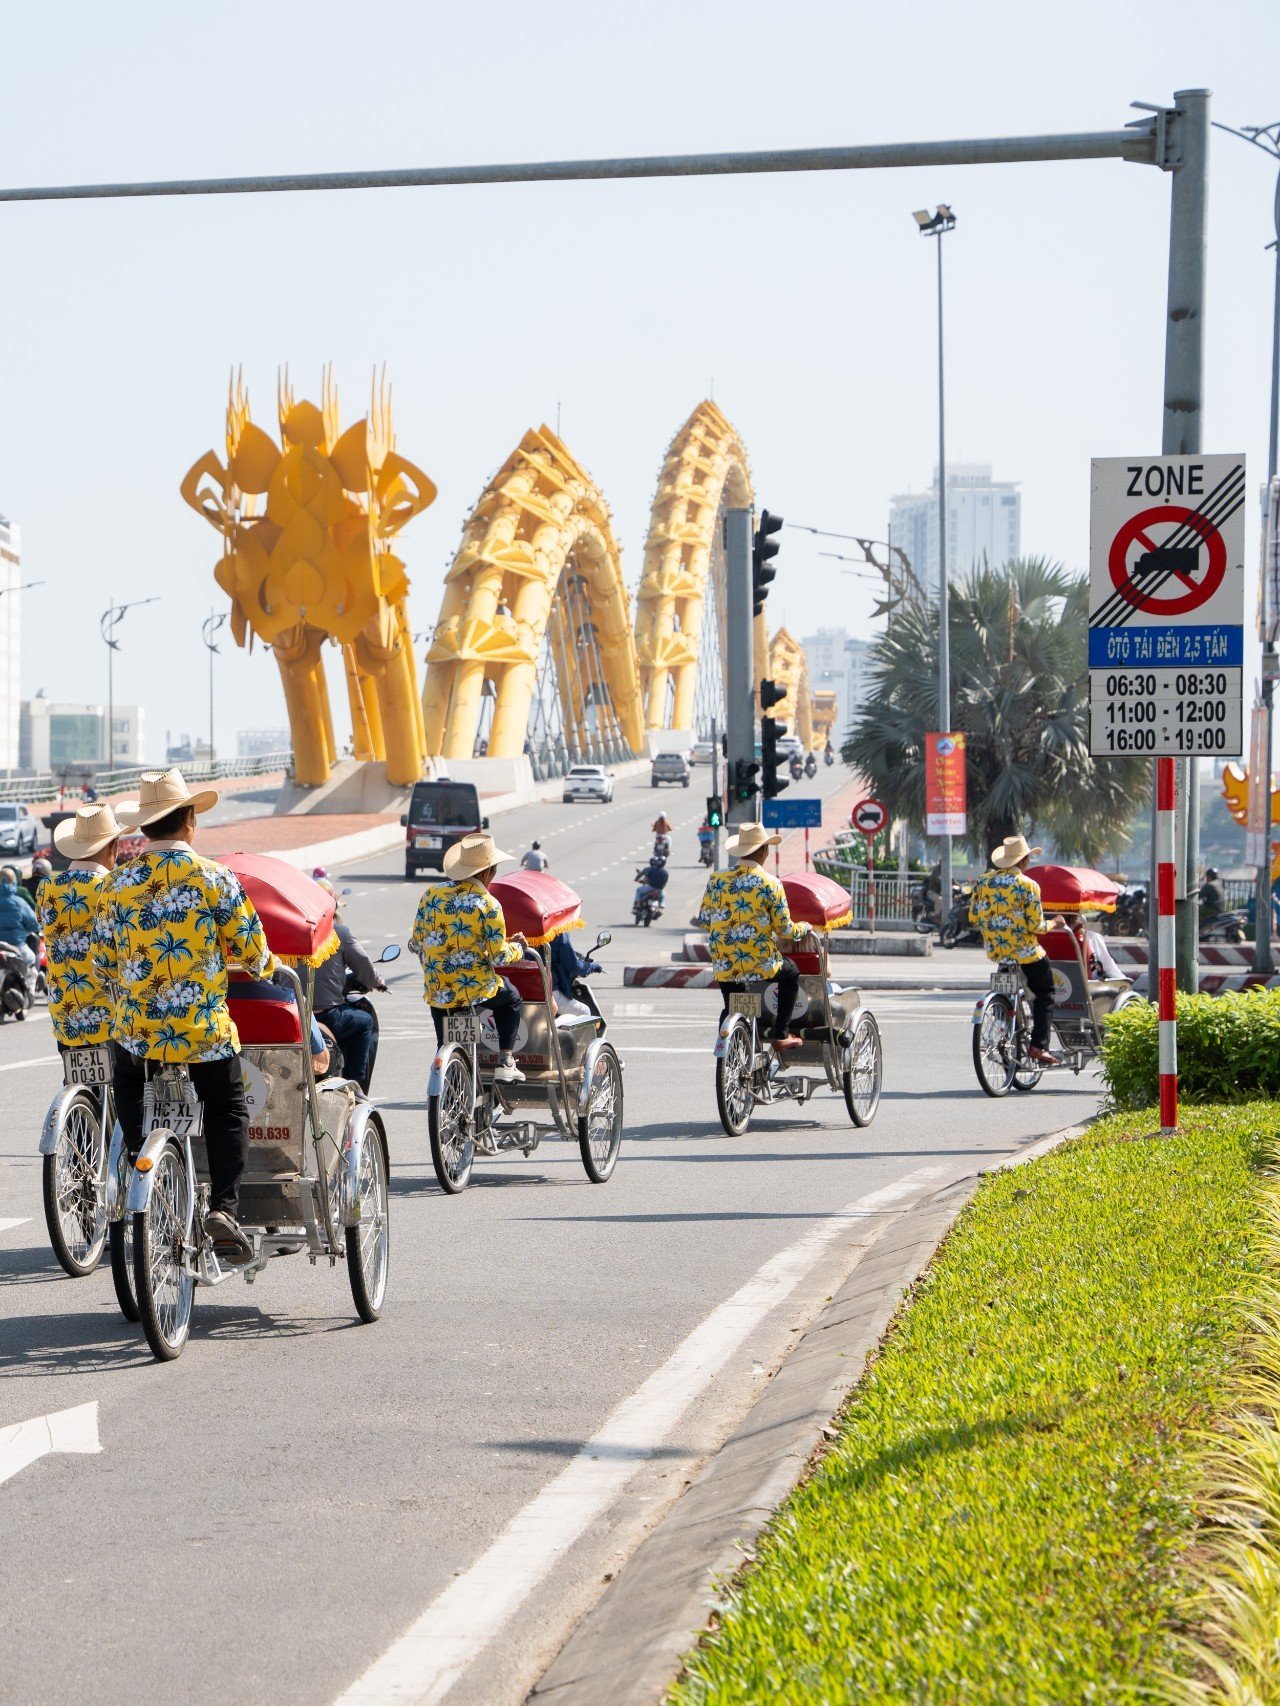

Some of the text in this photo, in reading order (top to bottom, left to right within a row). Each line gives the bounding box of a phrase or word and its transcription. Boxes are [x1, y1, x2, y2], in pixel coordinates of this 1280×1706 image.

[1126, 465, 1204, 497] ZONE
[1134, 630, 1153, 658] TẢI
[1157, 629, 1180, 658] ĐẾN
[1184, 635, 1201, 662] 2,5
[1106, 674, 1157, 696] 06:30
[1175, 673, 1227, 696] 08:30
[1106, 701, 1157, 723] 11:00
[1175, 700, 1226, 722] 12:00
[1106, 728, 1156, 750] 16:00
[1175, 728, 1226, 750] 19:00
[448, 1018, 476, 1030] HC-XL
[448, 1030, 476, 1042] 0025
[70, 1050, 104, 1068] HC-XL
[72, 1067, 105, 1084] 0030
[153, 1102, 194, 1118] HC-XL
[150, 1118, 194, 1134] 0077
[248, 1126, 290, 1140] 99.639
